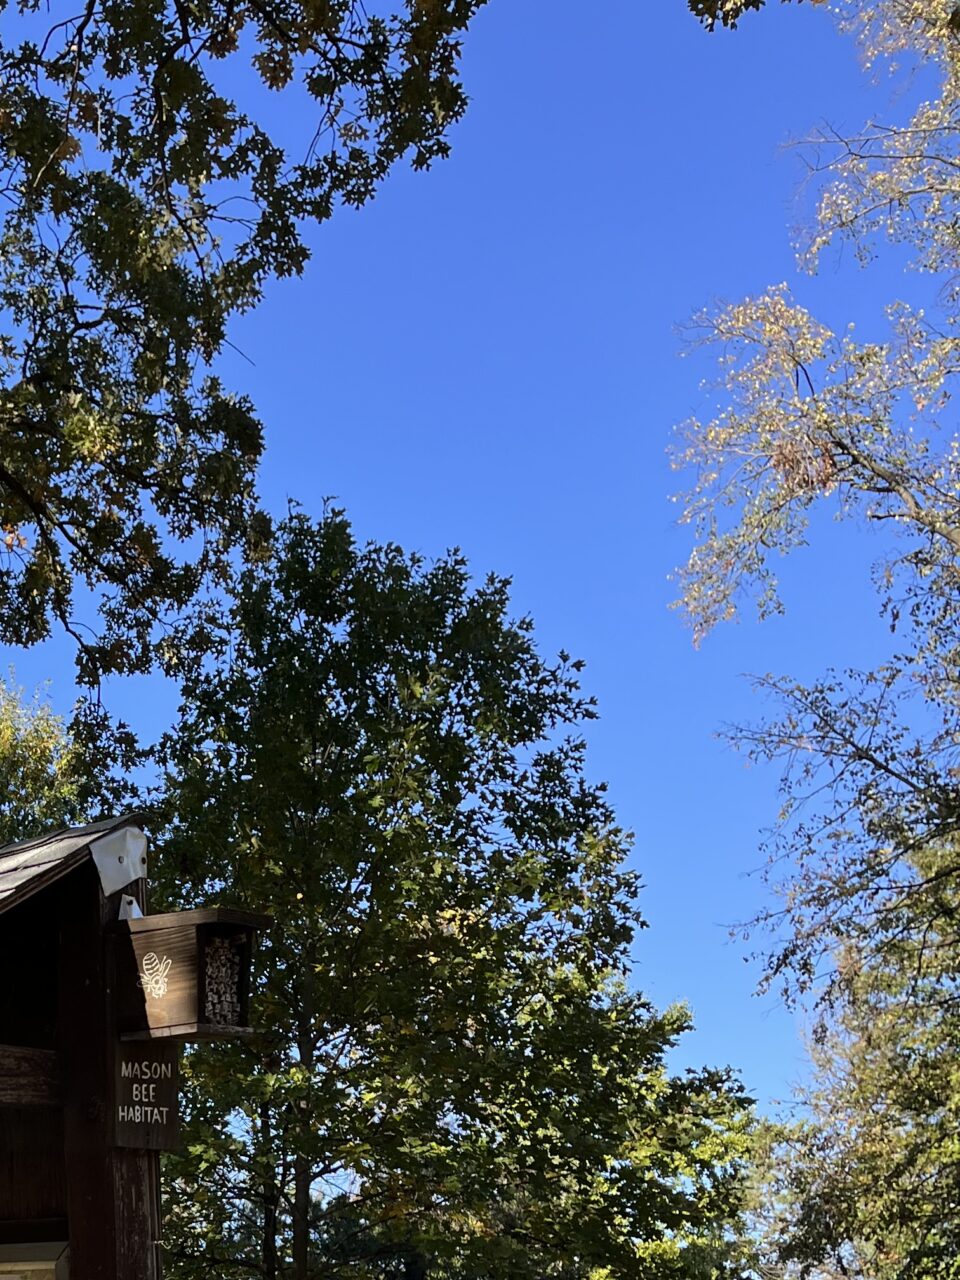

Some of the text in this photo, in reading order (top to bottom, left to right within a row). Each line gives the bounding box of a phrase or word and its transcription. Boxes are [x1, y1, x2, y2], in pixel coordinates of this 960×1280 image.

[121, 1061, 172, 1079] MASON
[132, 1084, 156, 1102] BEE
[118, 1105, 169, 1125] HABITAT
